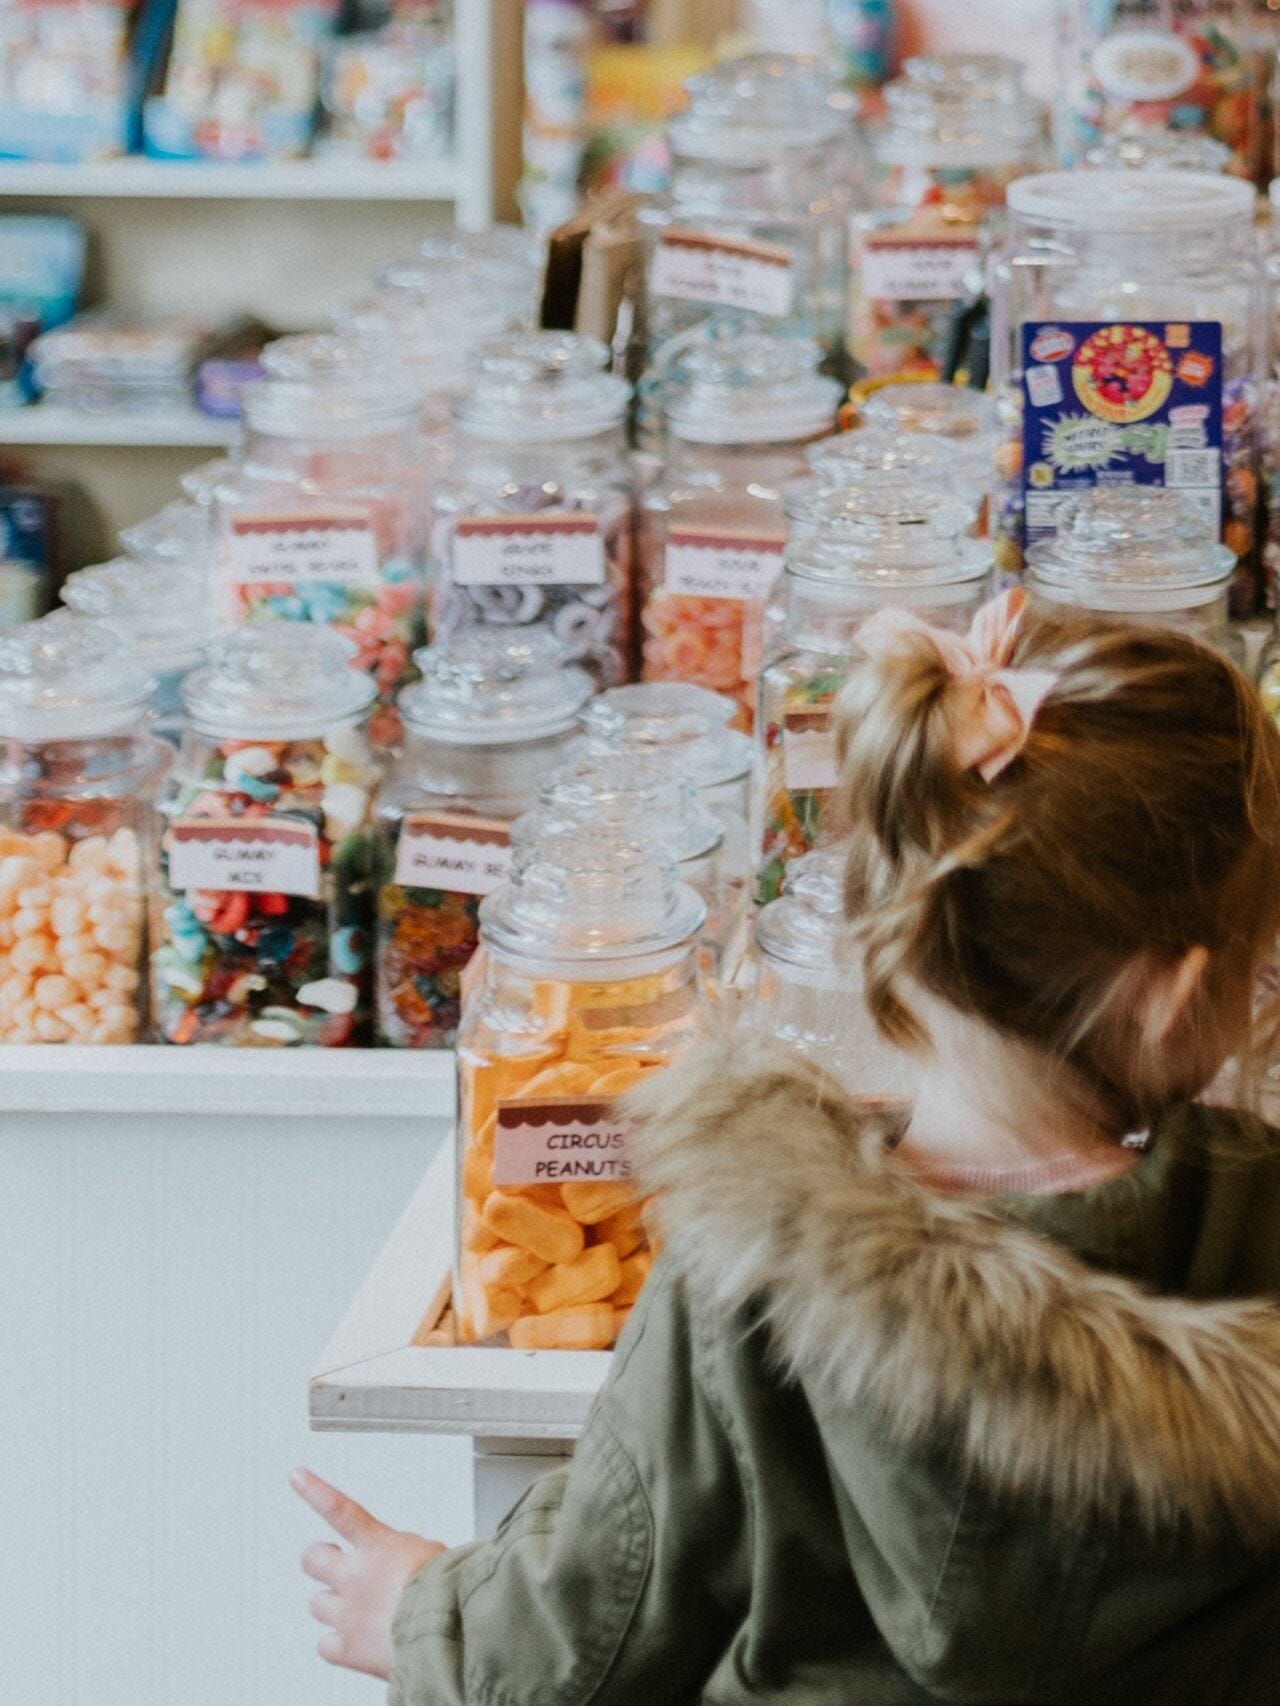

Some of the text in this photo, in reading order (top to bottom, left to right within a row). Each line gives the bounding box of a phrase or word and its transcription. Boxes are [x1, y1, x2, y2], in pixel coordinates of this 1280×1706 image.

[213, 848, 280, 863] GUMMY
[413, 853, 478, 873] GUMMY
[227, 871, 264, 885] MIX
[546, 1133, 624, 1150] CIRCUS
[535, 1159, 632, 1178] PEANUTS
